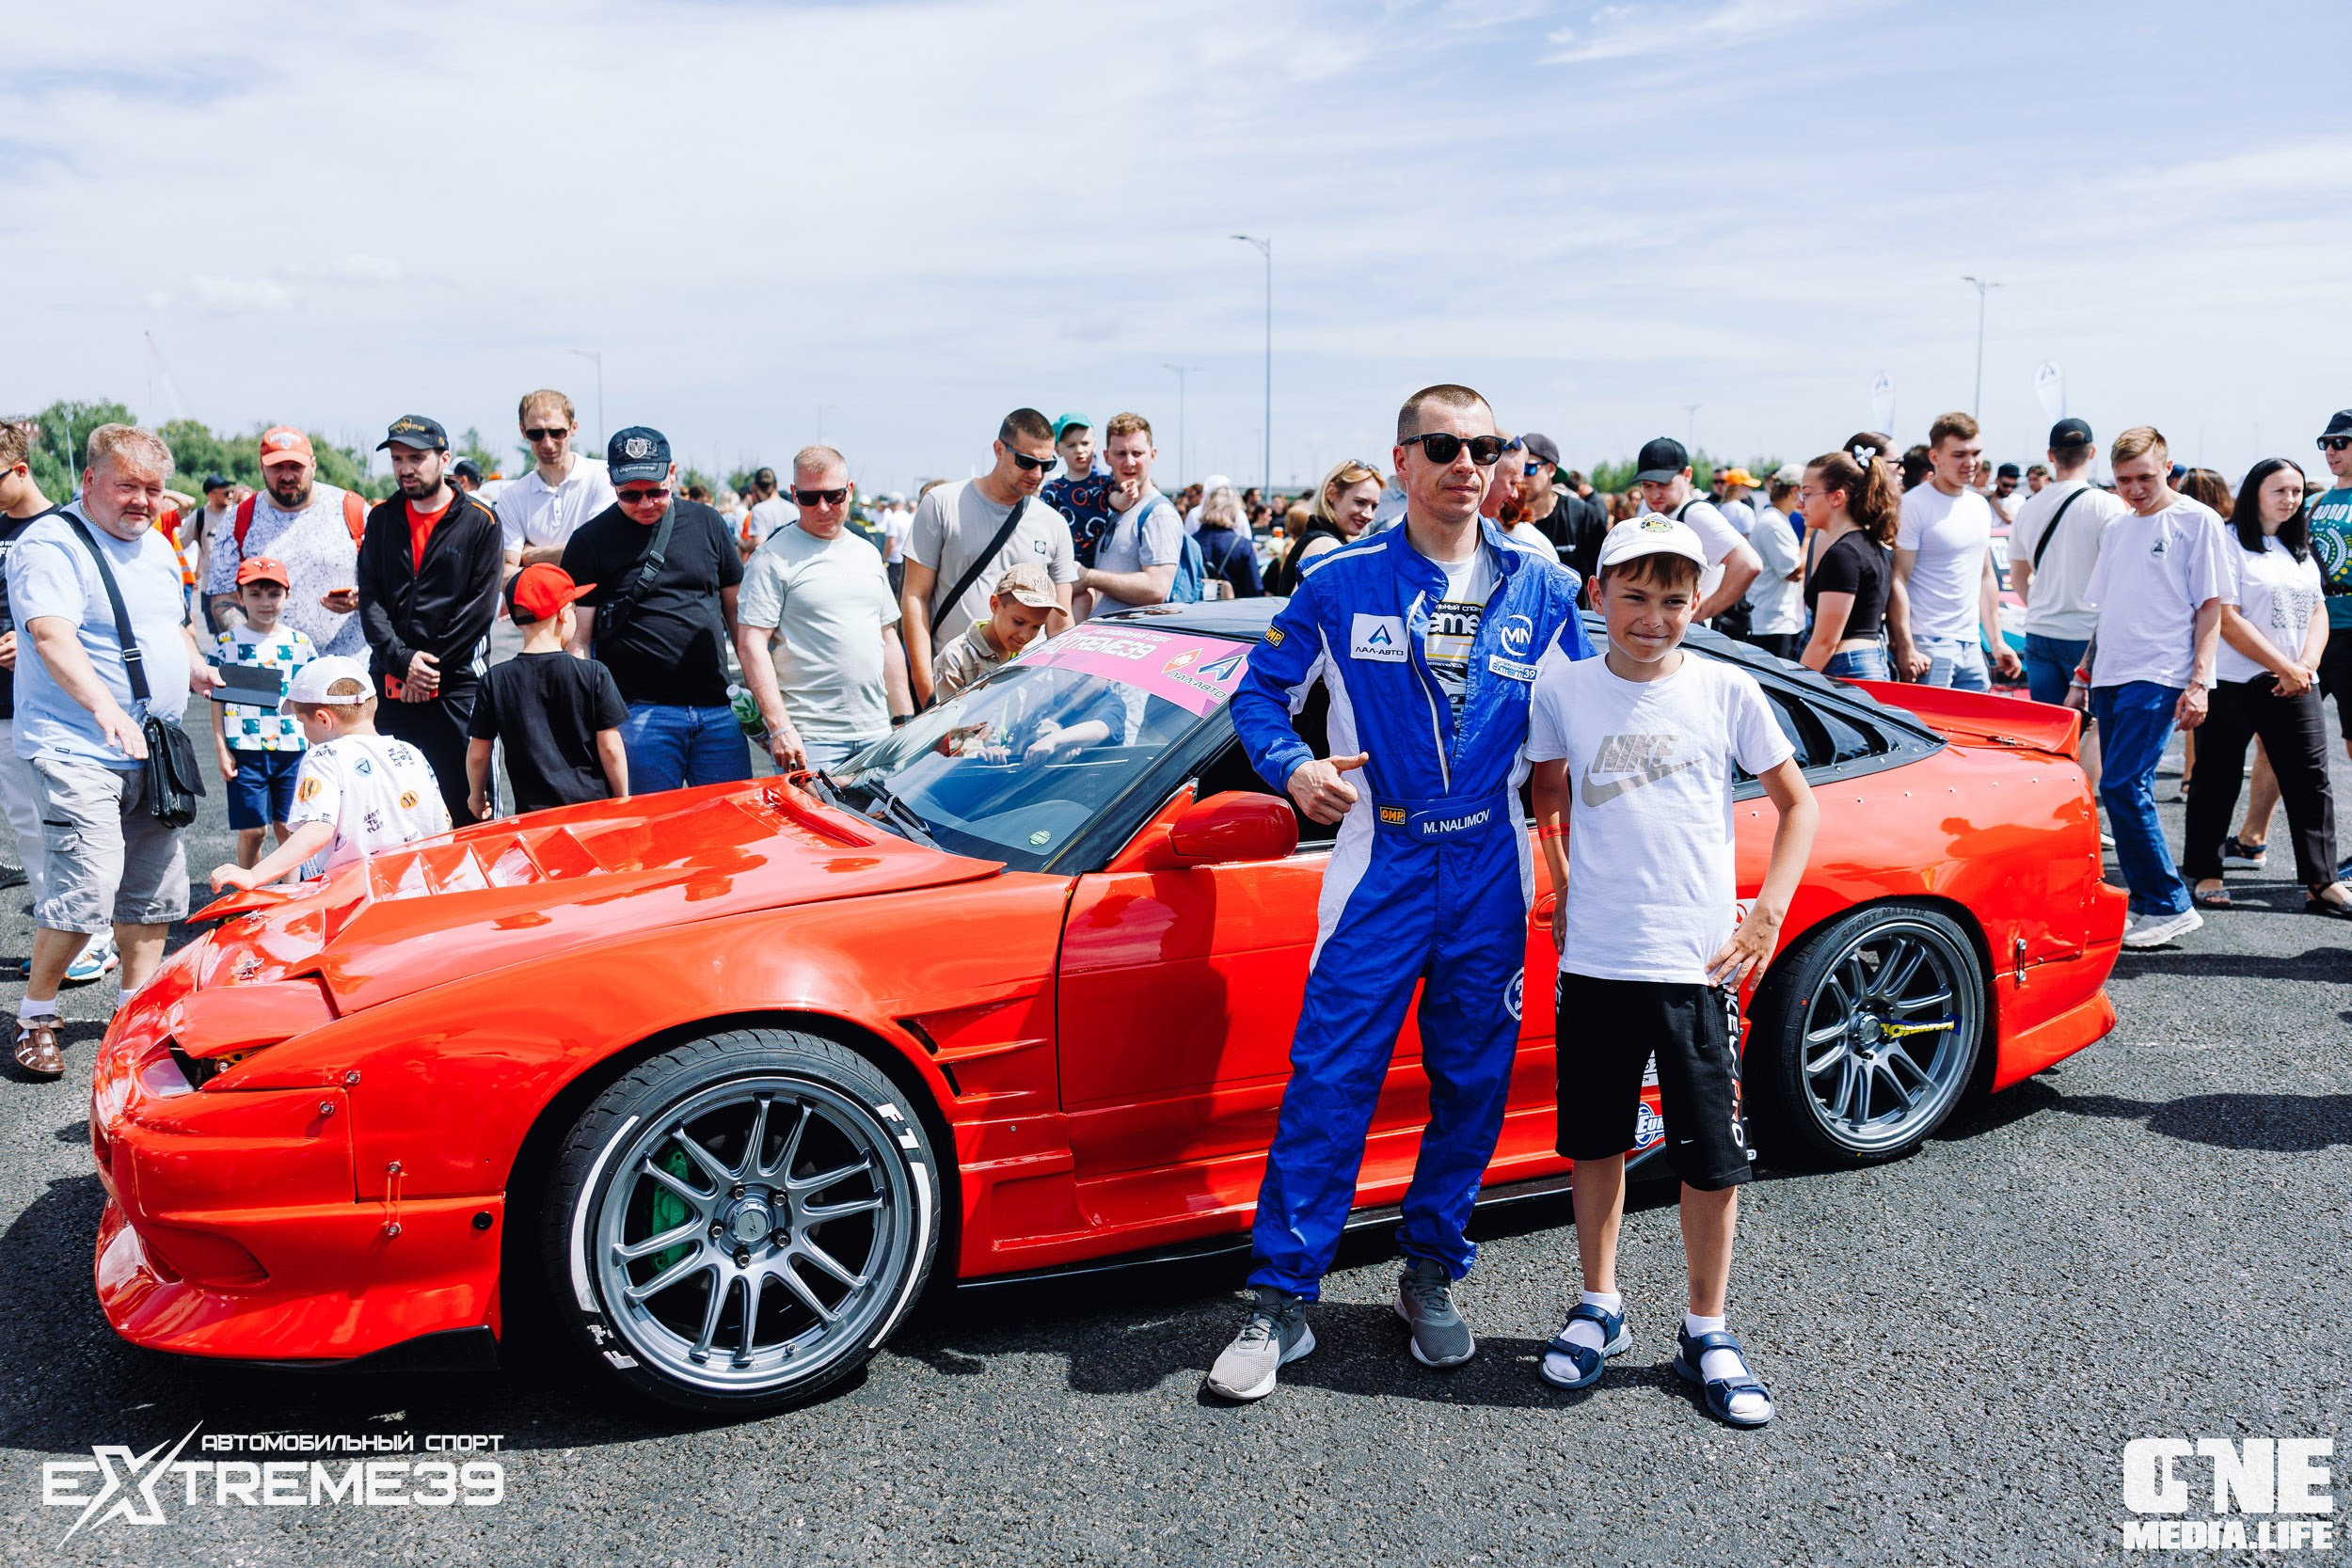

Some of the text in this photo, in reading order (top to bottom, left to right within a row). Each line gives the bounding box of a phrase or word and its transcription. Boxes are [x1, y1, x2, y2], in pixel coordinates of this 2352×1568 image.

[1592, 735, 1679, 773] NIKE
[1381, 809, 1405, 822] OMP
[1423, 808, 1490, 834] M. NALIMOV
[1841, 907, 1927, 941] SPORT MASTER
